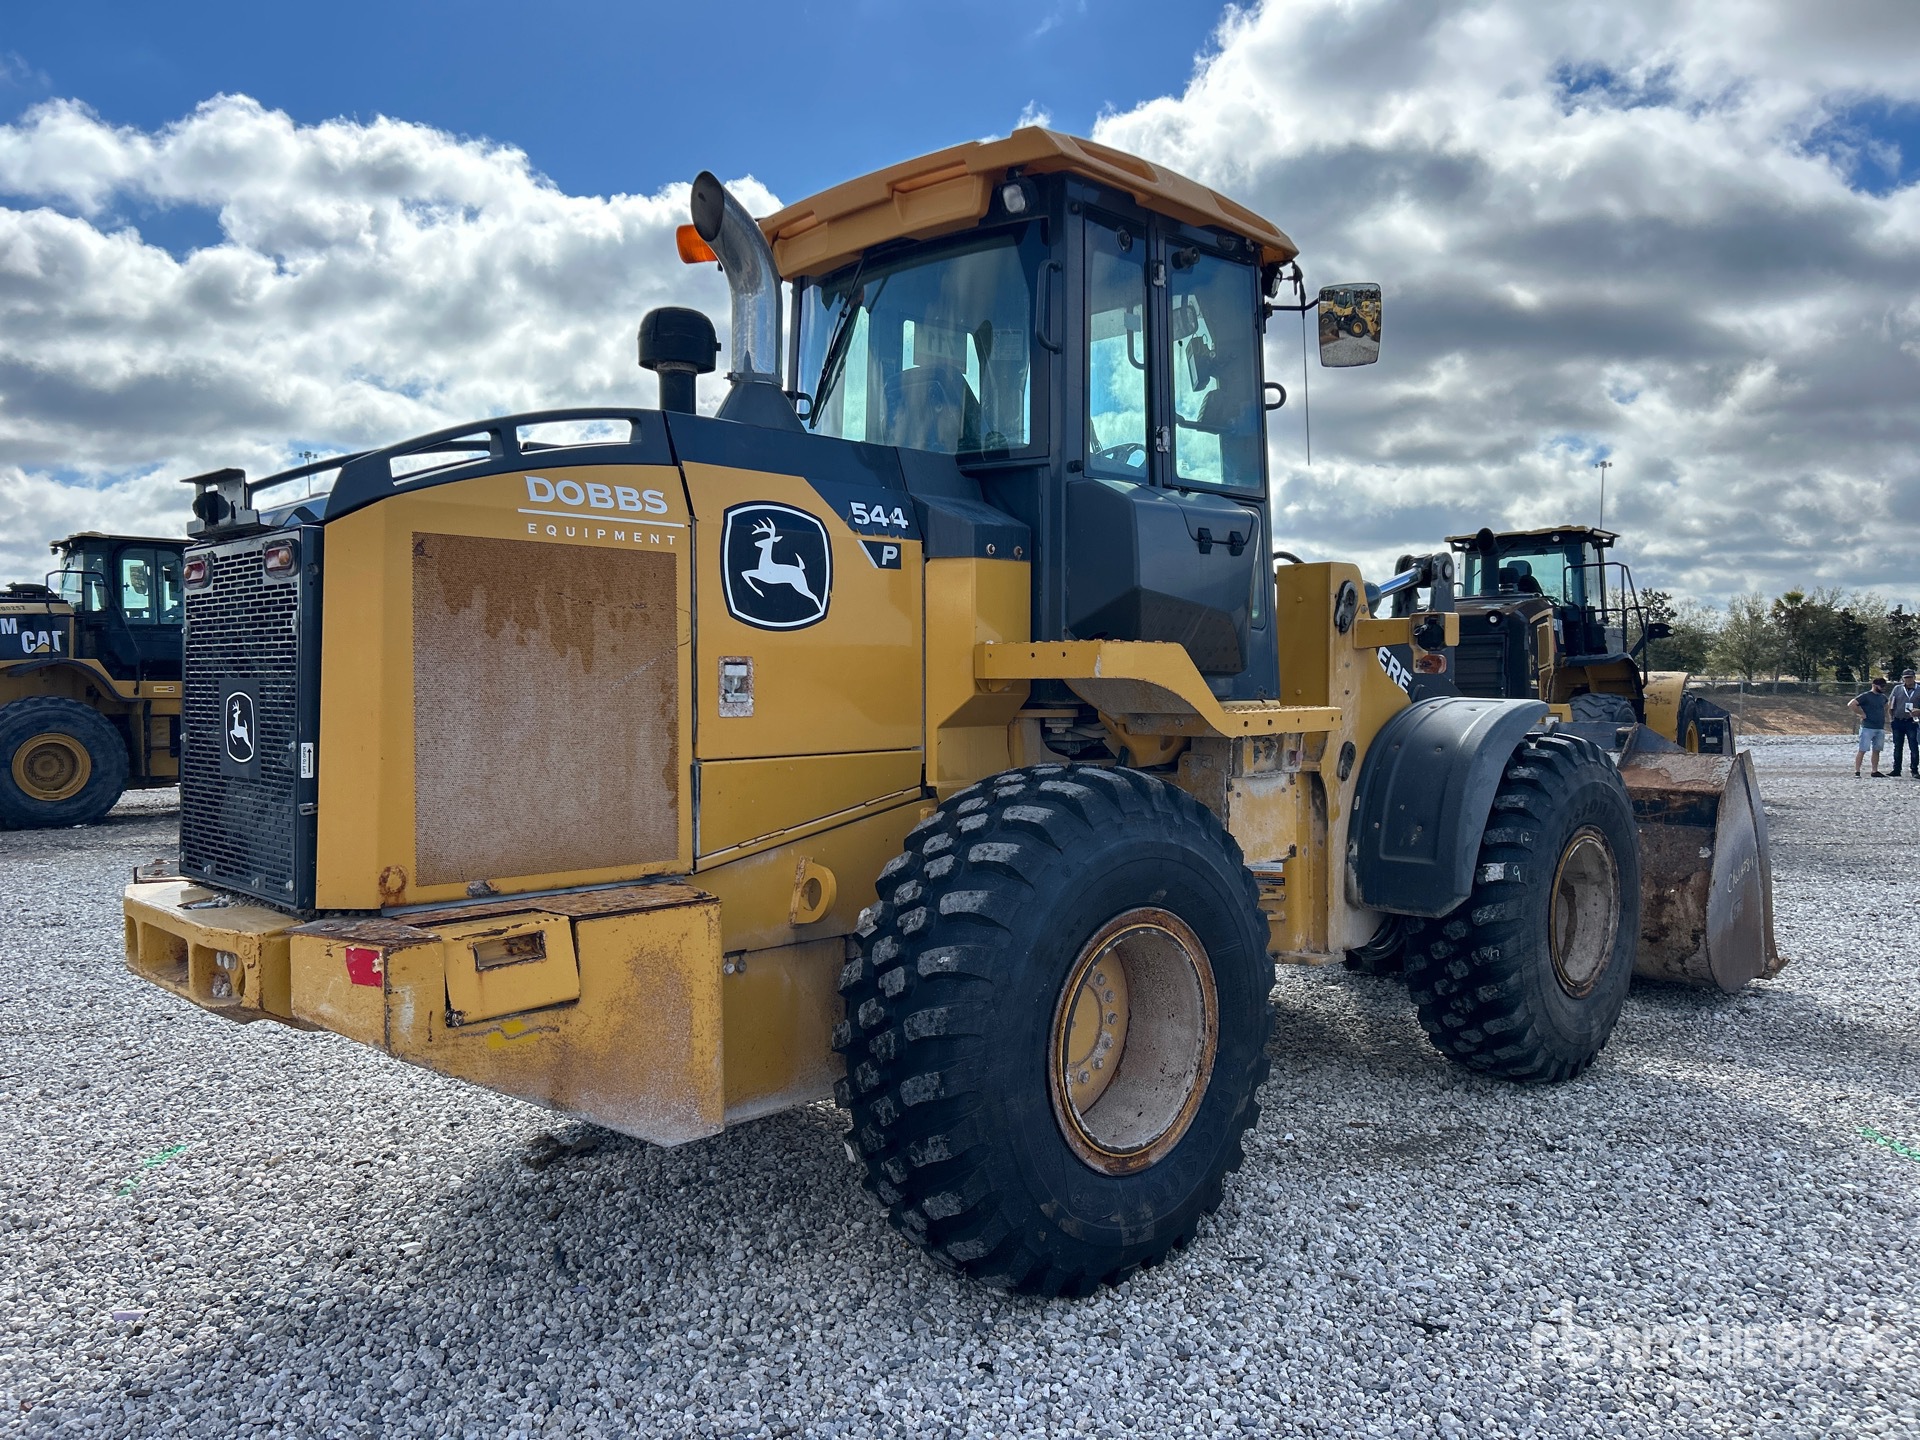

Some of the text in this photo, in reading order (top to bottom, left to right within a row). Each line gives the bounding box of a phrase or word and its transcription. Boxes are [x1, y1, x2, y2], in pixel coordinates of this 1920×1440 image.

[524, 475, 668, 514] DOBBS
[850, 501, 909, 529] 544
[527, 522, 676, 546] EQUIPMENT
[881, 545, 898, 565] P
[0, 617, 18, 635] M
[21, 630, 62, 654] CAT
